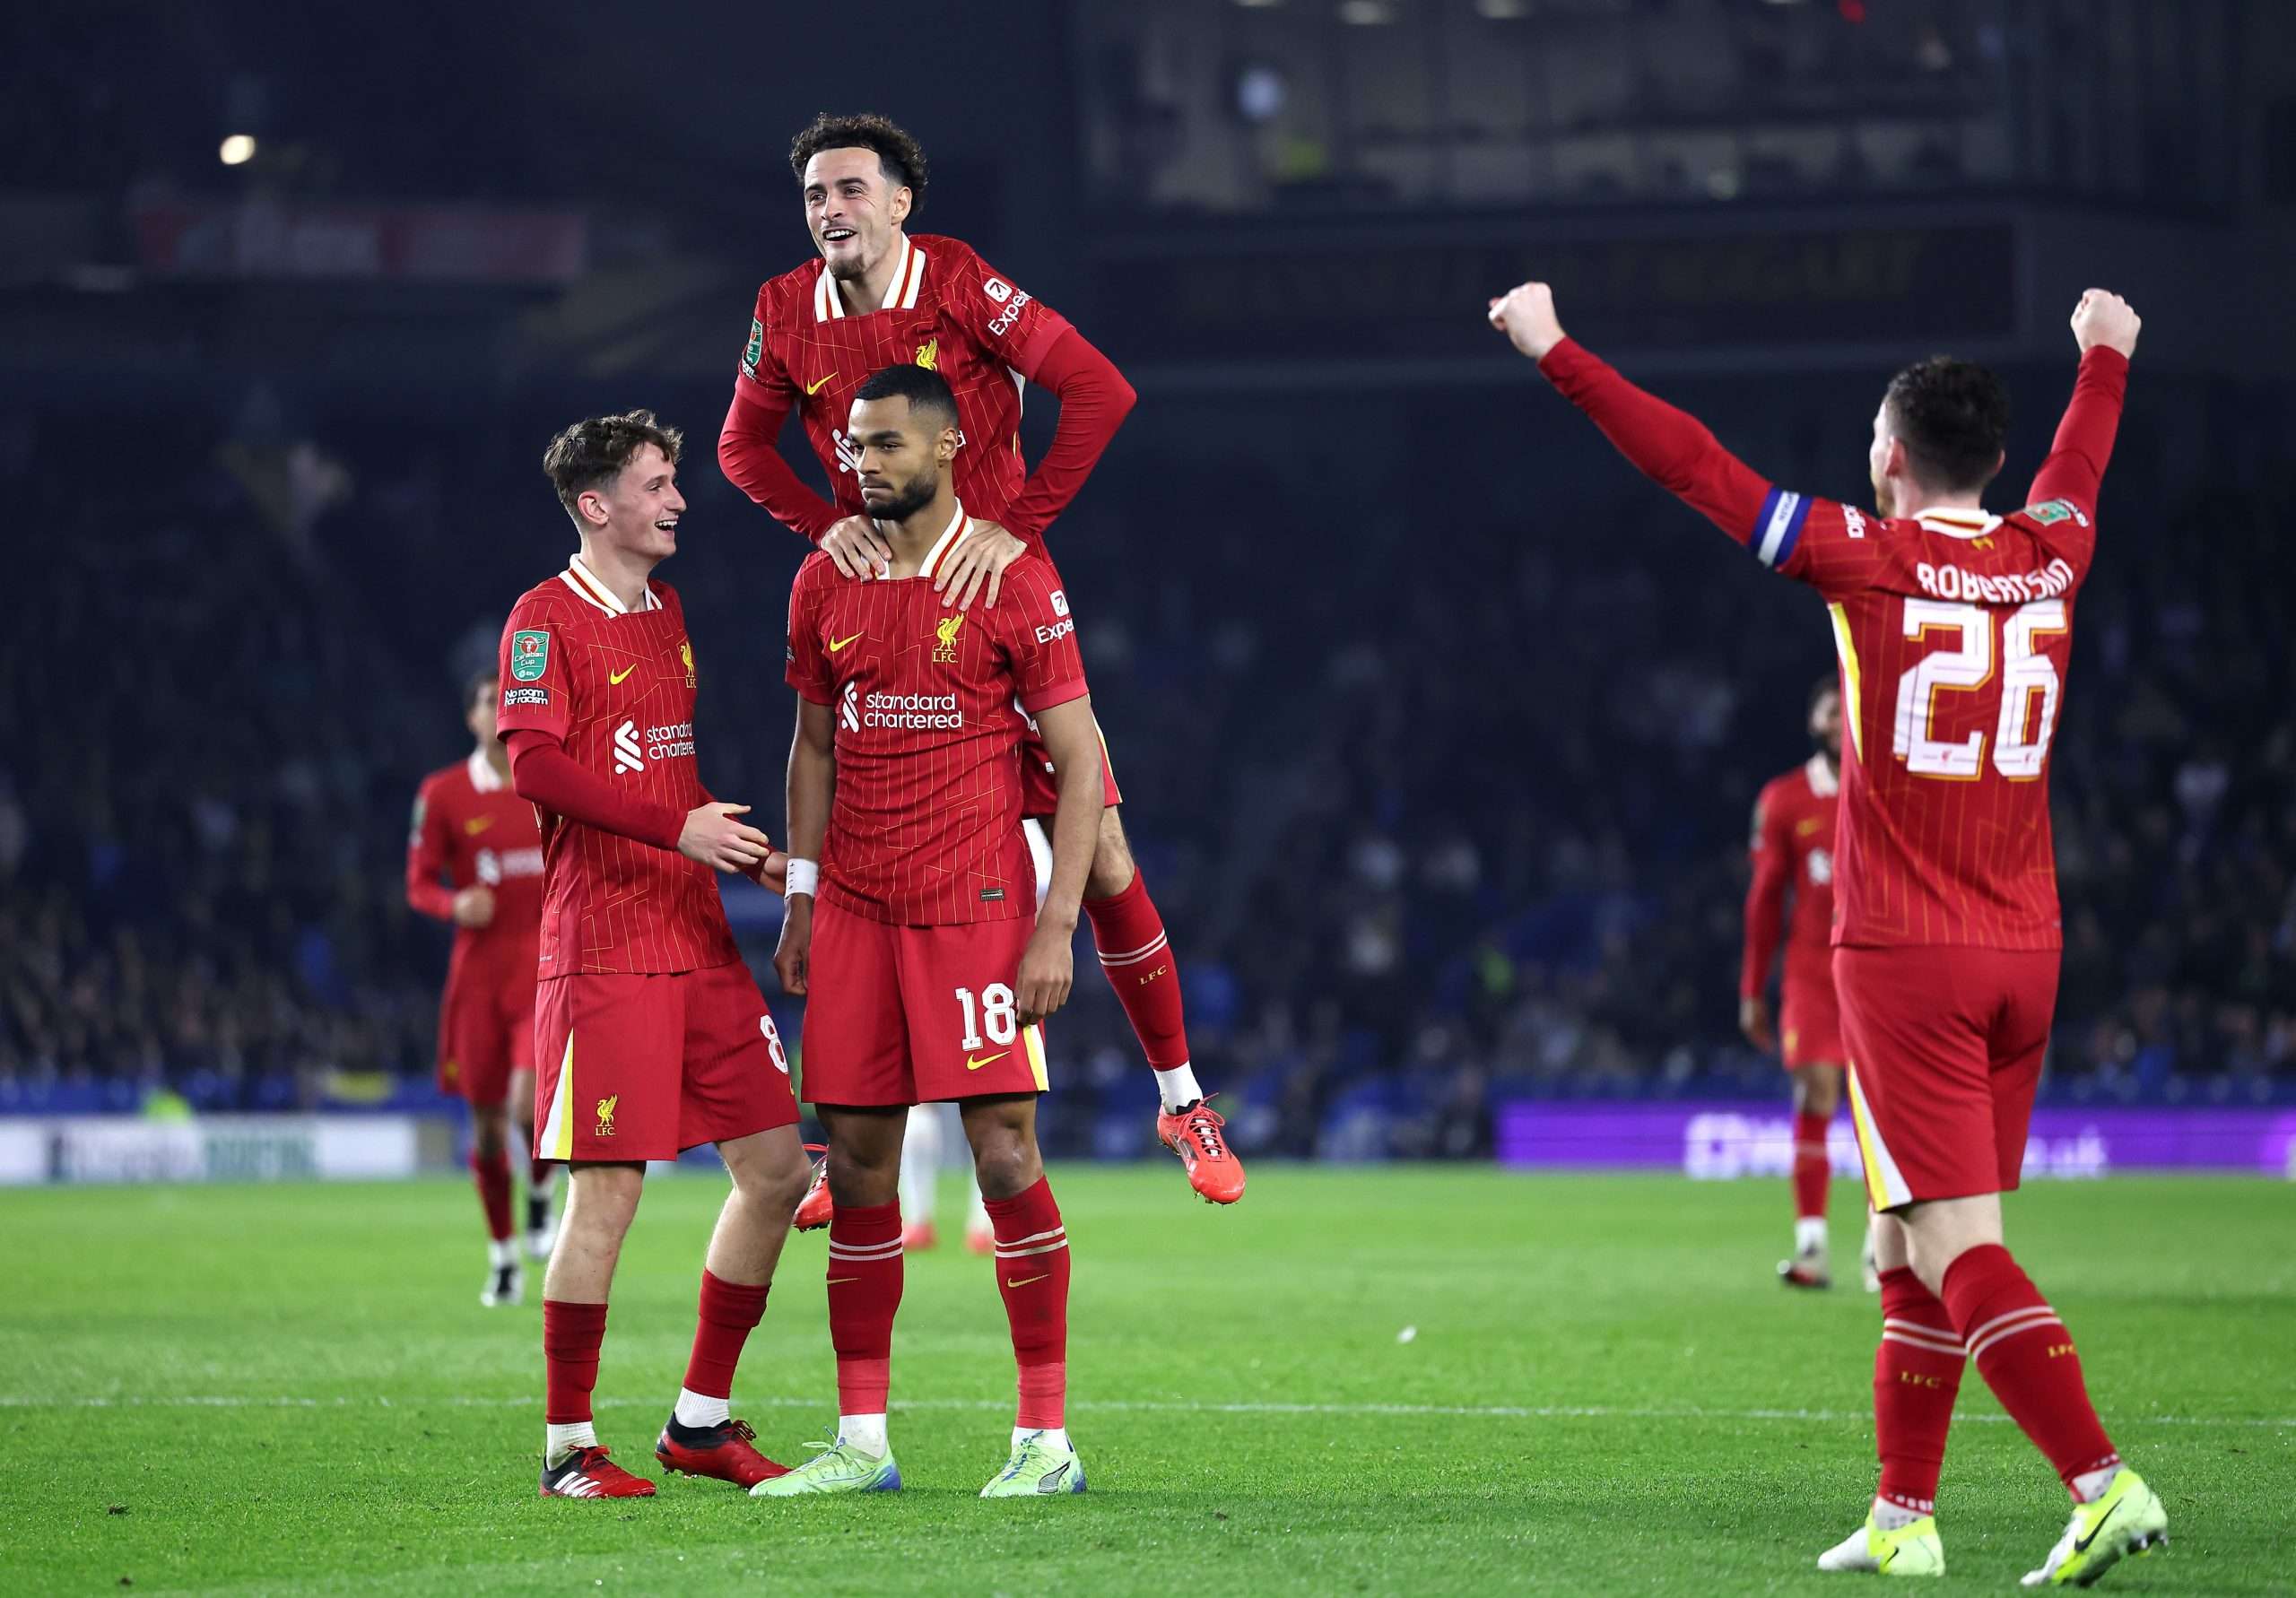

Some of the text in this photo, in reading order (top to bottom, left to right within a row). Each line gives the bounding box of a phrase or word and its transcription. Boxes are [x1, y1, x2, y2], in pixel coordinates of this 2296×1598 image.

[505, 689, 544, 698] No room
[1893, 597, 2067, 782] 26
[505, 696, 548, 707] for racism
[865, 691, 956, 709] standard
[864, 709, 962, 728] chartered
[1140, 965, 1166, 985] LFC
[955, 982, 1017, 1051] 18
